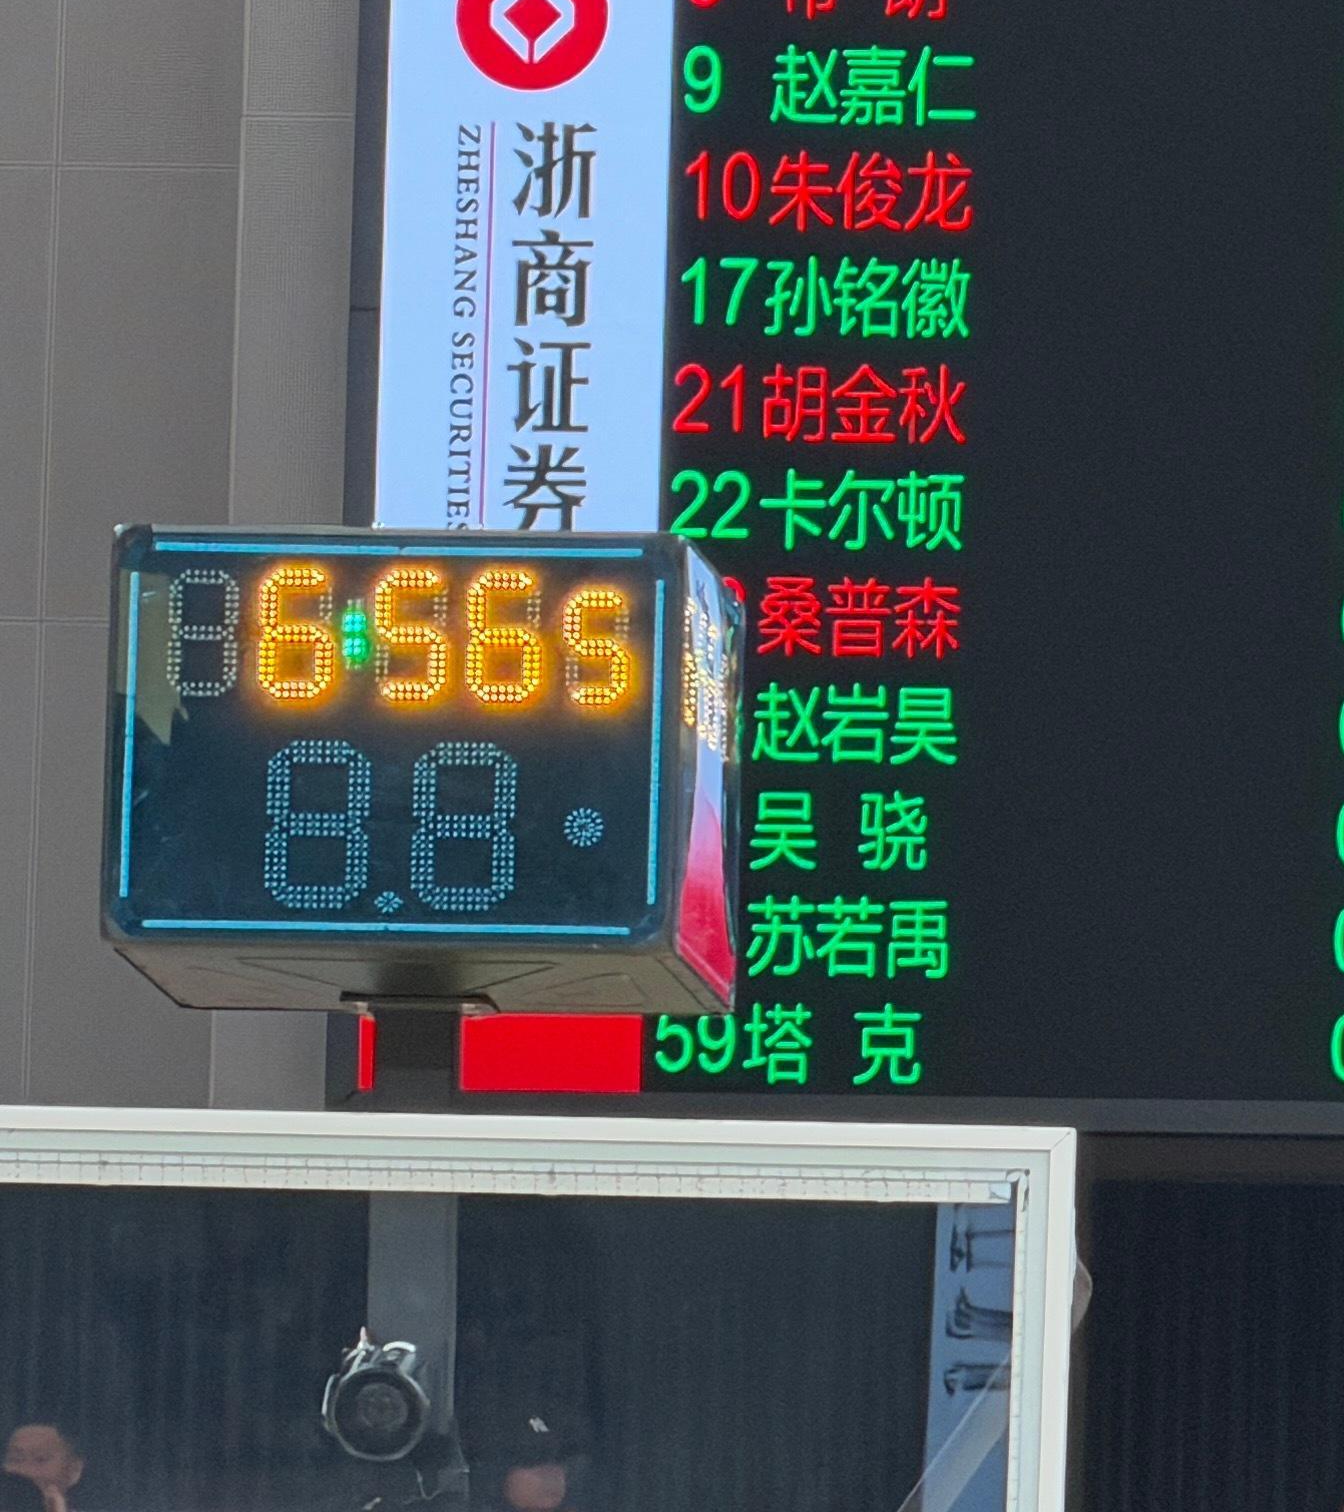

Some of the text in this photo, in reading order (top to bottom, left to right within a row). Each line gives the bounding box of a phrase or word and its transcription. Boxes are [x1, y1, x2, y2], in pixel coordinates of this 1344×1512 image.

[683, 43, 723, 115] 9
[768, 42, 978, 128] 赵嘉仁
[452, 124, 482, 318] ZHESHANG
[684, 148, 763, 222] 10
[767, 148, 975, 234] 朱俊龙
[503, 121, 599, 531] 浙商证券
[679, 255, 760, 327] 17
[762, 254, 973, 340] 孙铭徽
[671, 361, 747, 435] 21
[761, 362, 967, 446] 胡金秋
[666, 468, 752, 541] 22
[758, 466, 966, 552] 卡尔顿
[755, 575, 962, 660] 桑普森
[750, 680, 959, 766] 赵岩昊
[744, 893, 950, 980] 苏若禹
[654, 1012, 738, 1075] 59
